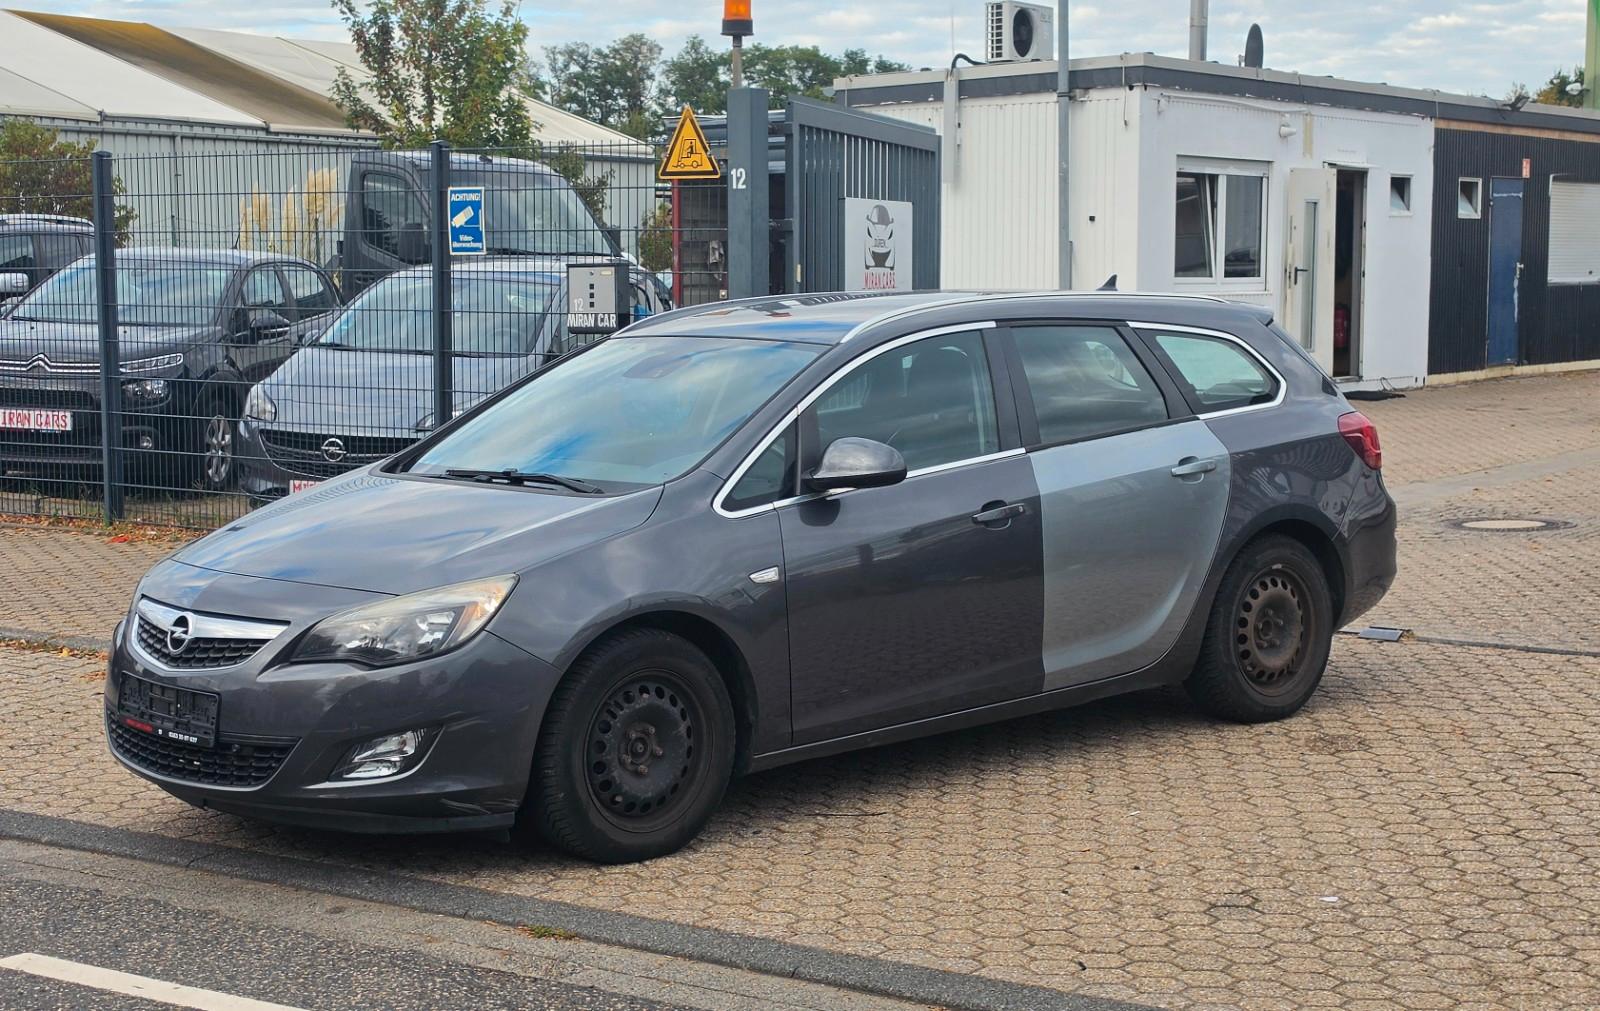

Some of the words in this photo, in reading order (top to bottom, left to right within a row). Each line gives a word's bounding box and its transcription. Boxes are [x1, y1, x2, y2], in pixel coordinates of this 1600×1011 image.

[731, 168, 746, 189] 12
[451, 193, 481, 202] ACHTUNG!
[864, 272, 881, 288] MIRAN
[882, 272, 896, 288] CARS
[574, 298, 584, 311] 12
[567, 313, 595, 328] MIRAN
[597, 313, 616, 328] CAR
[1, 411, 32, 427] IRAN
[35, 412, 68, 429] CARS
